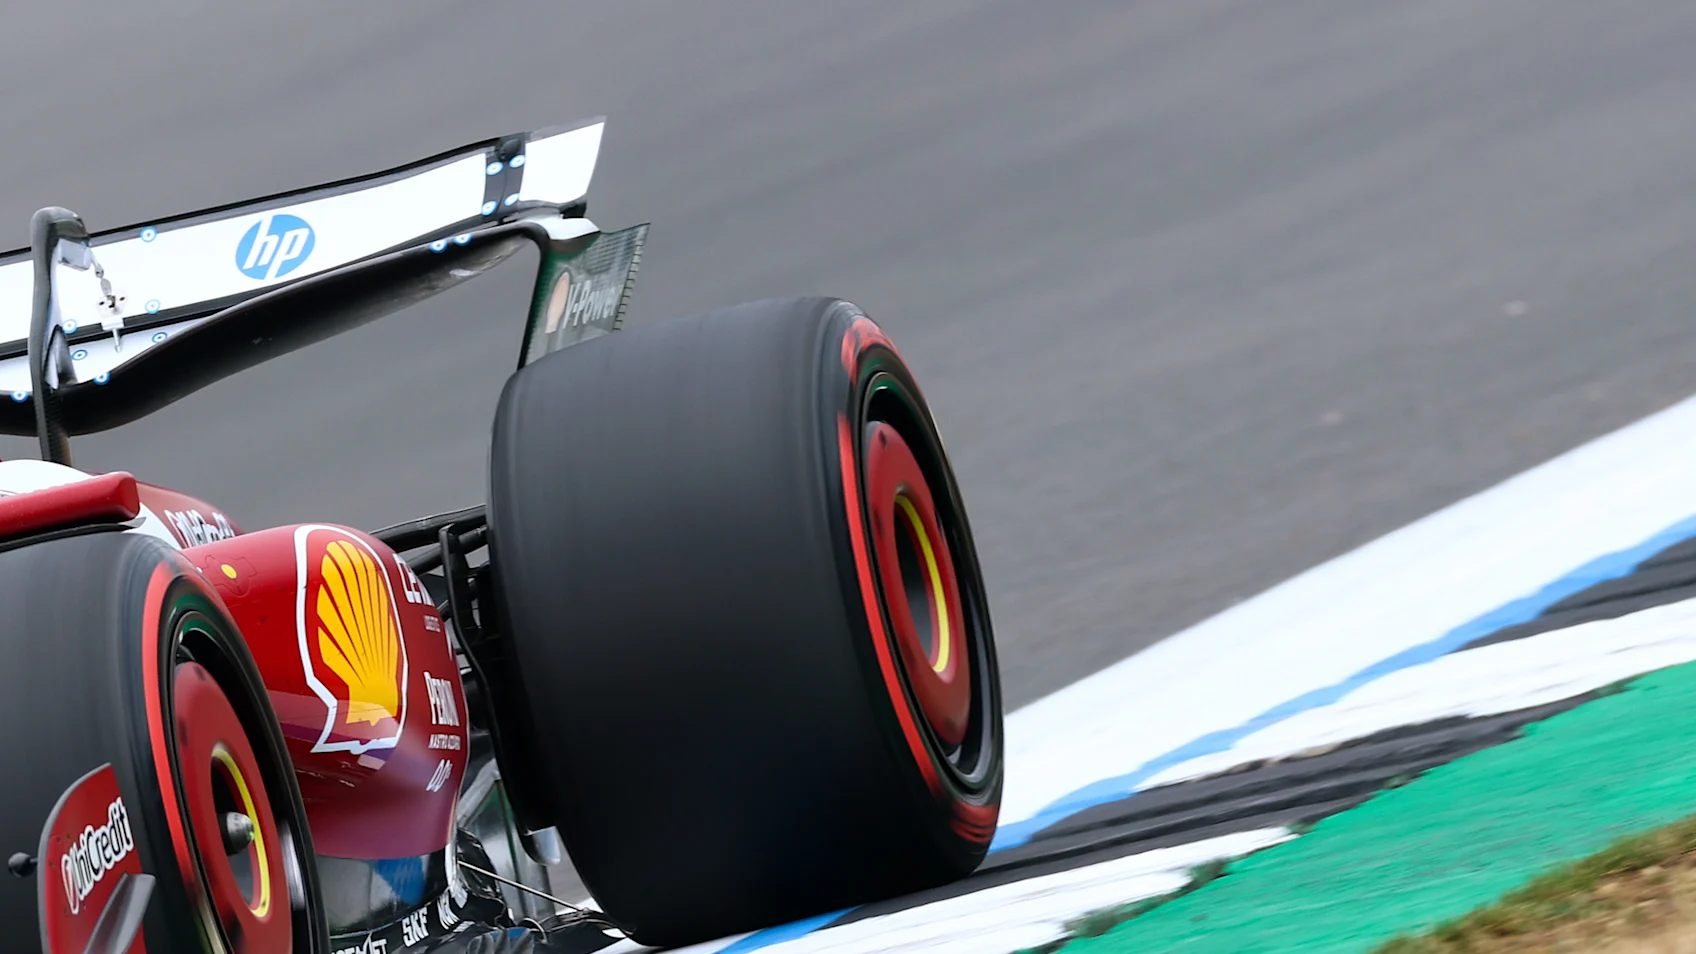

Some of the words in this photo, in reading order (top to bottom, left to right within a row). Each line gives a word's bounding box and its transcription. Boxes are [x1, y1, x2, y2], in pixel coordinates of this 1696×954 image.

[235, 214, 315, 280] hp
[562, 280, 617, 329] V-Power
[67, 796, 134, 902] UniCredit
[402, 906, 430, 948] SKF
